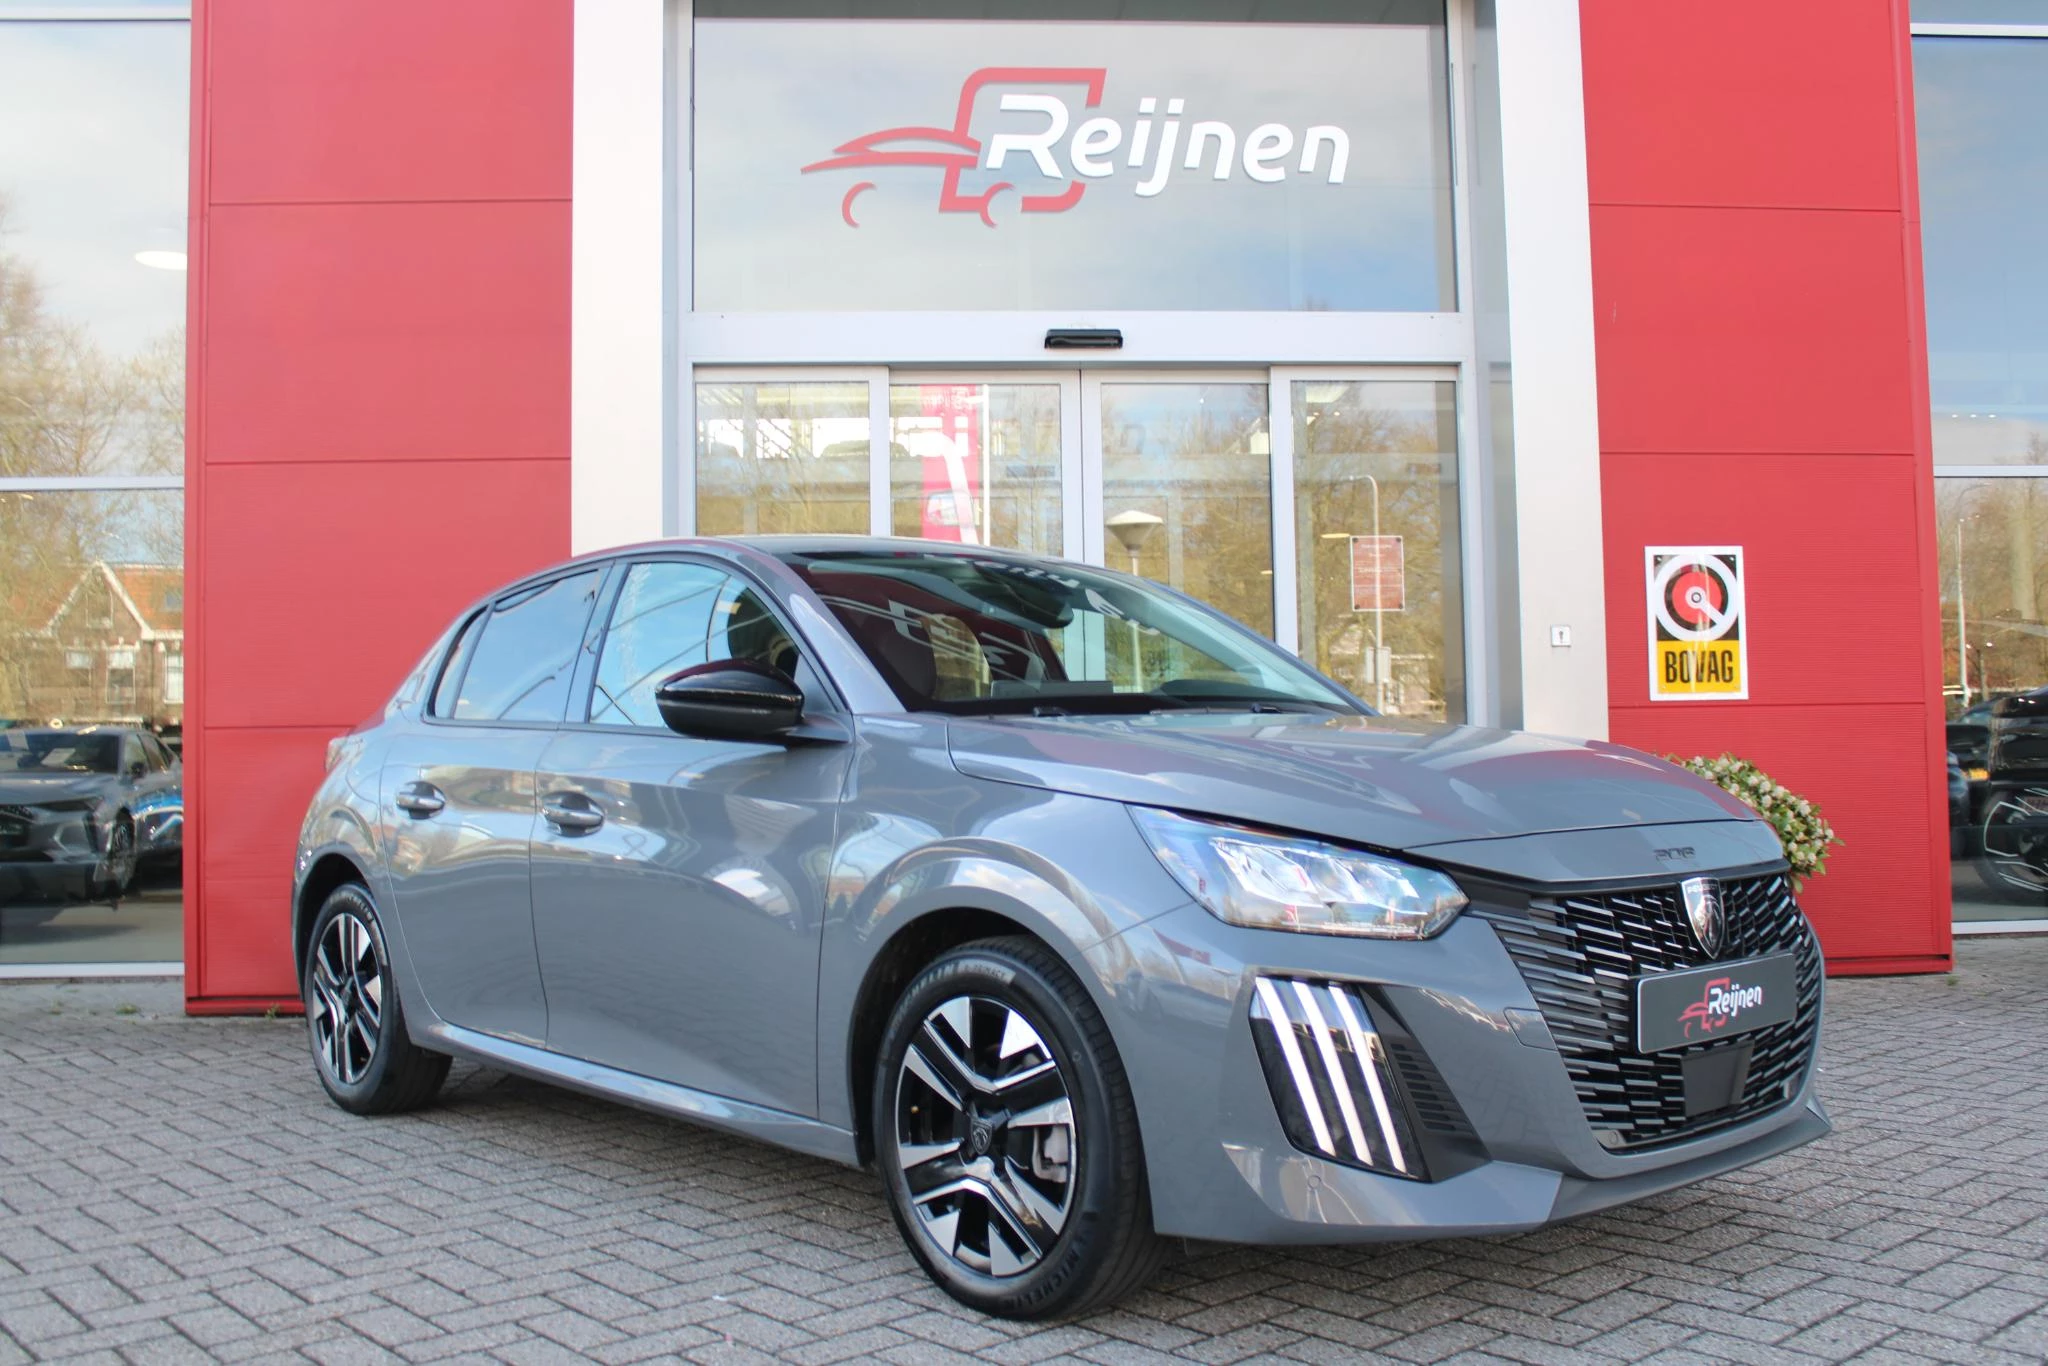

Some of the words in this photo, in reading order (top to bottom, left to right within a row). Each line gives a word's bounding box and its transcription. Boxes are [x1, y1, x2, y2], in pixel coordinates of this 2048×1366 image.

[986, 94, 1350, 197] Reijnen
[1665, 649, 1734, 684] BOVAG
[1708, 983, 1762, 1017] Reijnen
